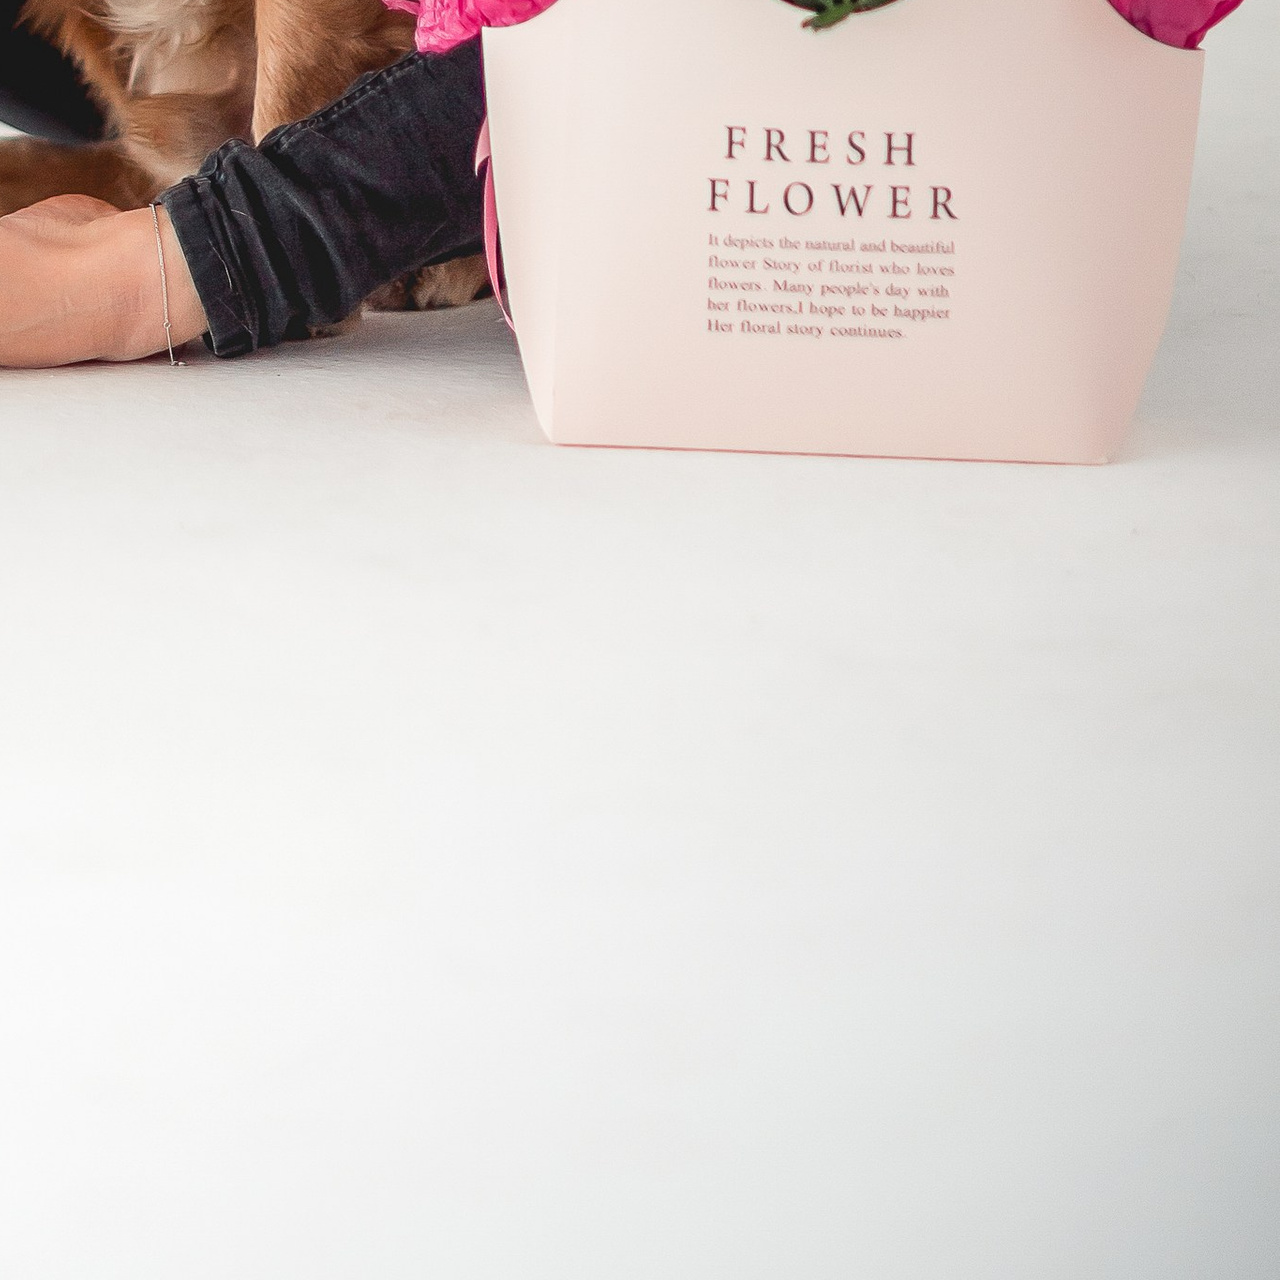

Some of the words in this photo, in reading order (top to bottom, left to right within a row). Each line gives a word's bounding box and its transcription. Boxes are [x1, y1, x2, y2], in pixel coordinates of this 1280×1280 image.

[725, 125, 916, 166] FRESH
[707, 178, 958, 220] FLOWER
[709, 233, 719, 246] It
[723, 234, 774, 251] depicts
[779, 236, 801, 250] the
[805, 238, 855, 252] natural
[860, 239, 887, 253] and
[890, 240, 955, 255] beautiful
[709, 255, 756, 269] flower
[763, 257, 801, 274] Story
[808, 259, 825, 272] of
[829, 260, 873, 274] florist
[879, 261, 910, 275] who
[917, 262, 955, 276] loves
[773, 279, 813, 296] Many
[821, 282, 880, 297] people's
[885, 283, 910, 299] day
[918, 285, 949, 298] with
[707, 297, 730, 311] her
[809, 301, 845, 318] hope
[852, 306, 866, 316] to
[871, 303, 888, 317] be
[893, 304, 950, 321] happier
[707, 319, 734, 333] Her
[741, 320, 781, 334] floral
[786, 324, 823, 339] story
